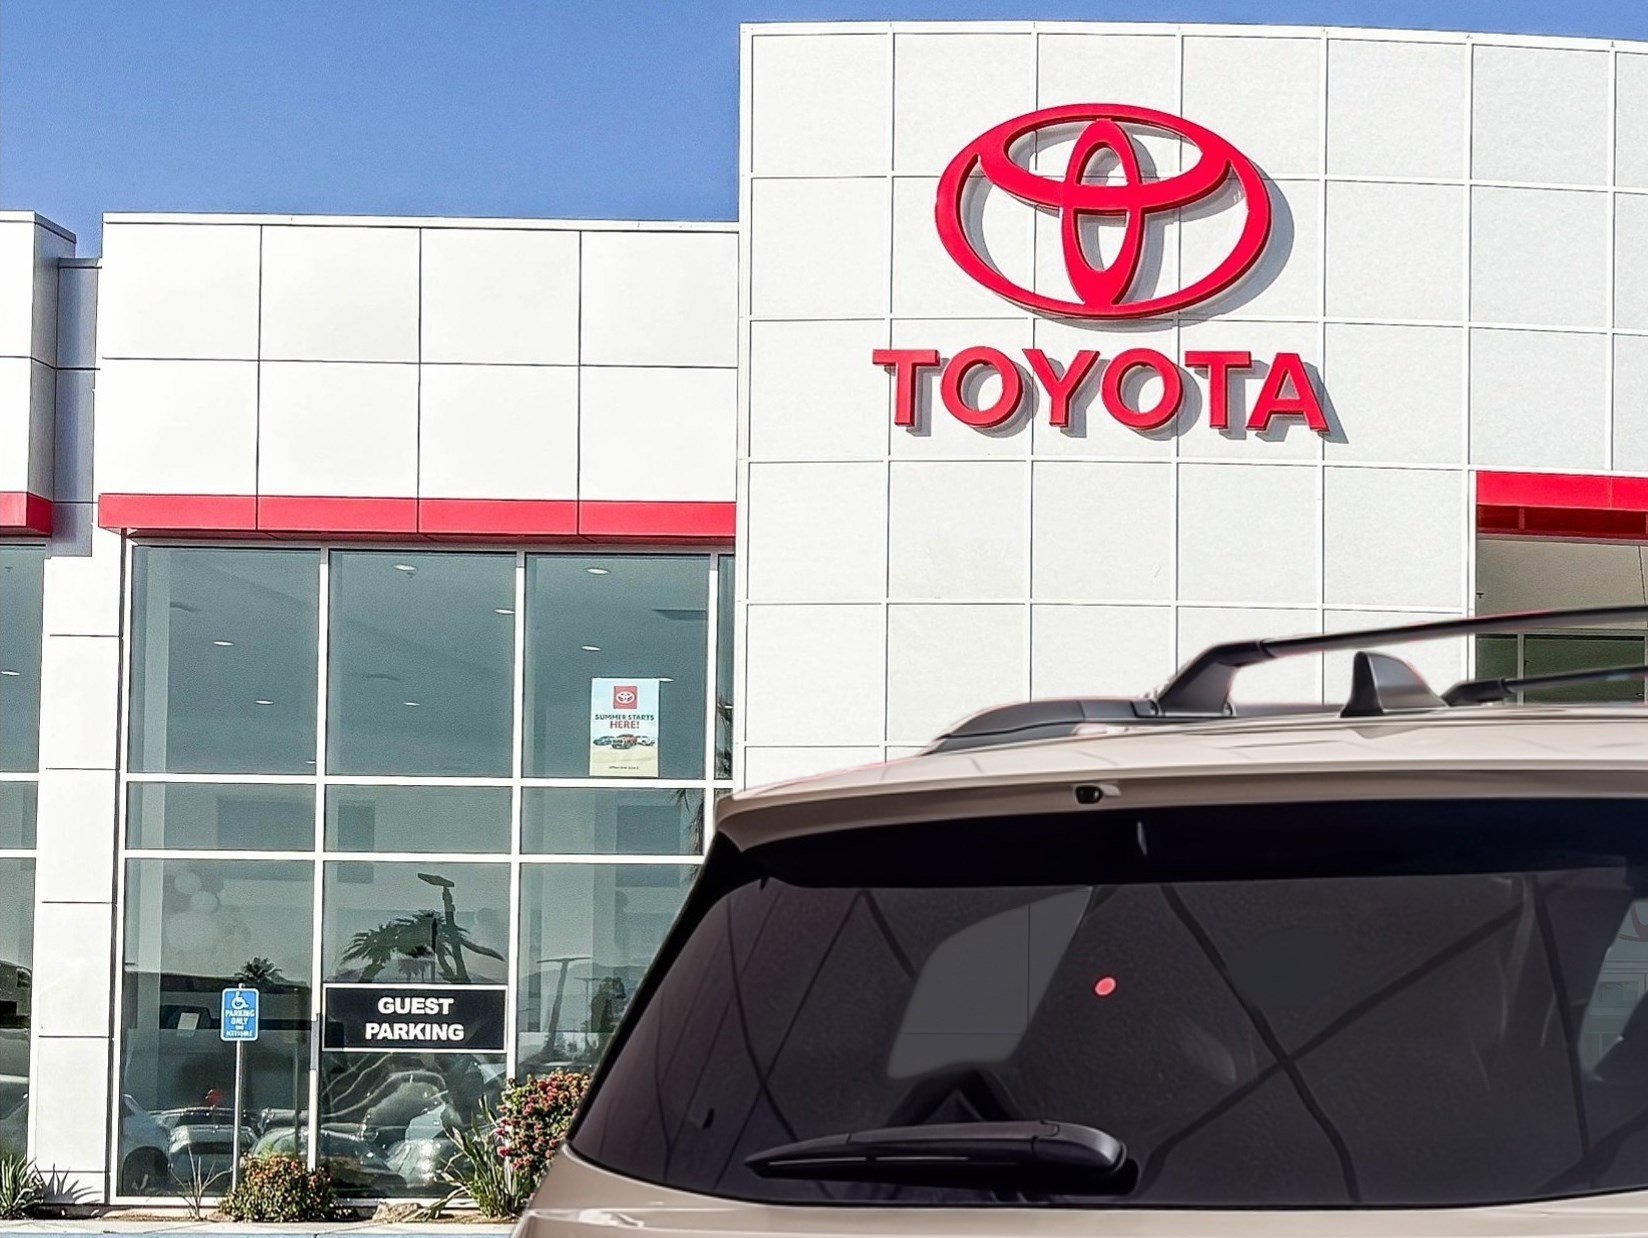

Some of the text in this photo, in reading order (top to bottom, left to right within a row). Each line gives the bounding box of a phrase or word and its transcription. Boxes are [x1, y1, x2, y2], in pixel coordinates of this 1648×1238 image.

[872, 346, 1330, 433] TOYOTA
[609, 721, 640, 729] HERE!
[377, 997, 454, 1015] GUEST
[365, 1023, 464, 1041] PARKING
